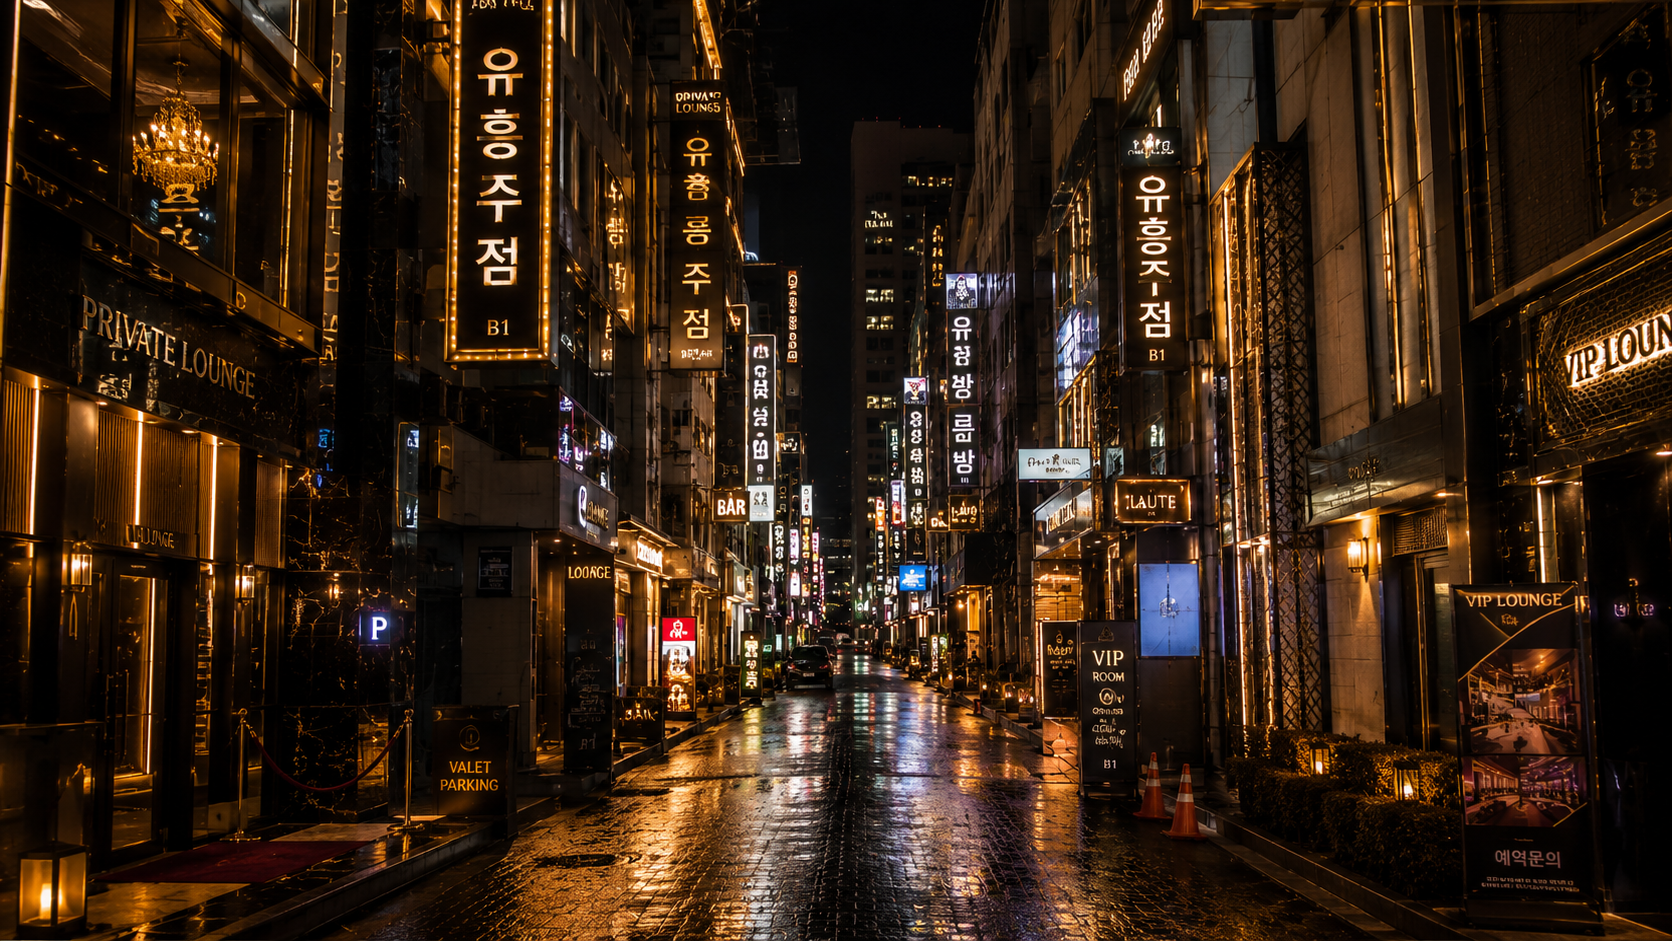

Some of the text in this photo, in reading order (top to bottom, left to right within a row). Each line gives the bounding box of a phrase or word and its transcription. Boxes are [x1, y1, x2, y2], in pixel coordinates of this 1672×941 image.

[476, 46, 524, 287] 유흥주점
[1135, 175, 1172, 339] 유흥주점
[486, 320, 510, 337] B1
[81, 294, 177, 367] PRIVATE
[181, 340, 256, 400] LOUNGE
[1148, 349, 1165, 362] B1
[1562, 346, 1597, 386] VIP
[717, 498, 746, 516] BAR
[1465, 593, 1562, 608] VIP LOUNGE
[371, 616, 387, 640] P
[1092, 650, 1124, 667] VIP
[1092, 671, 1125, 683] ROOM
[448, 760, 492, 774] VALET
[440, 778, 499, 792] PARKING
